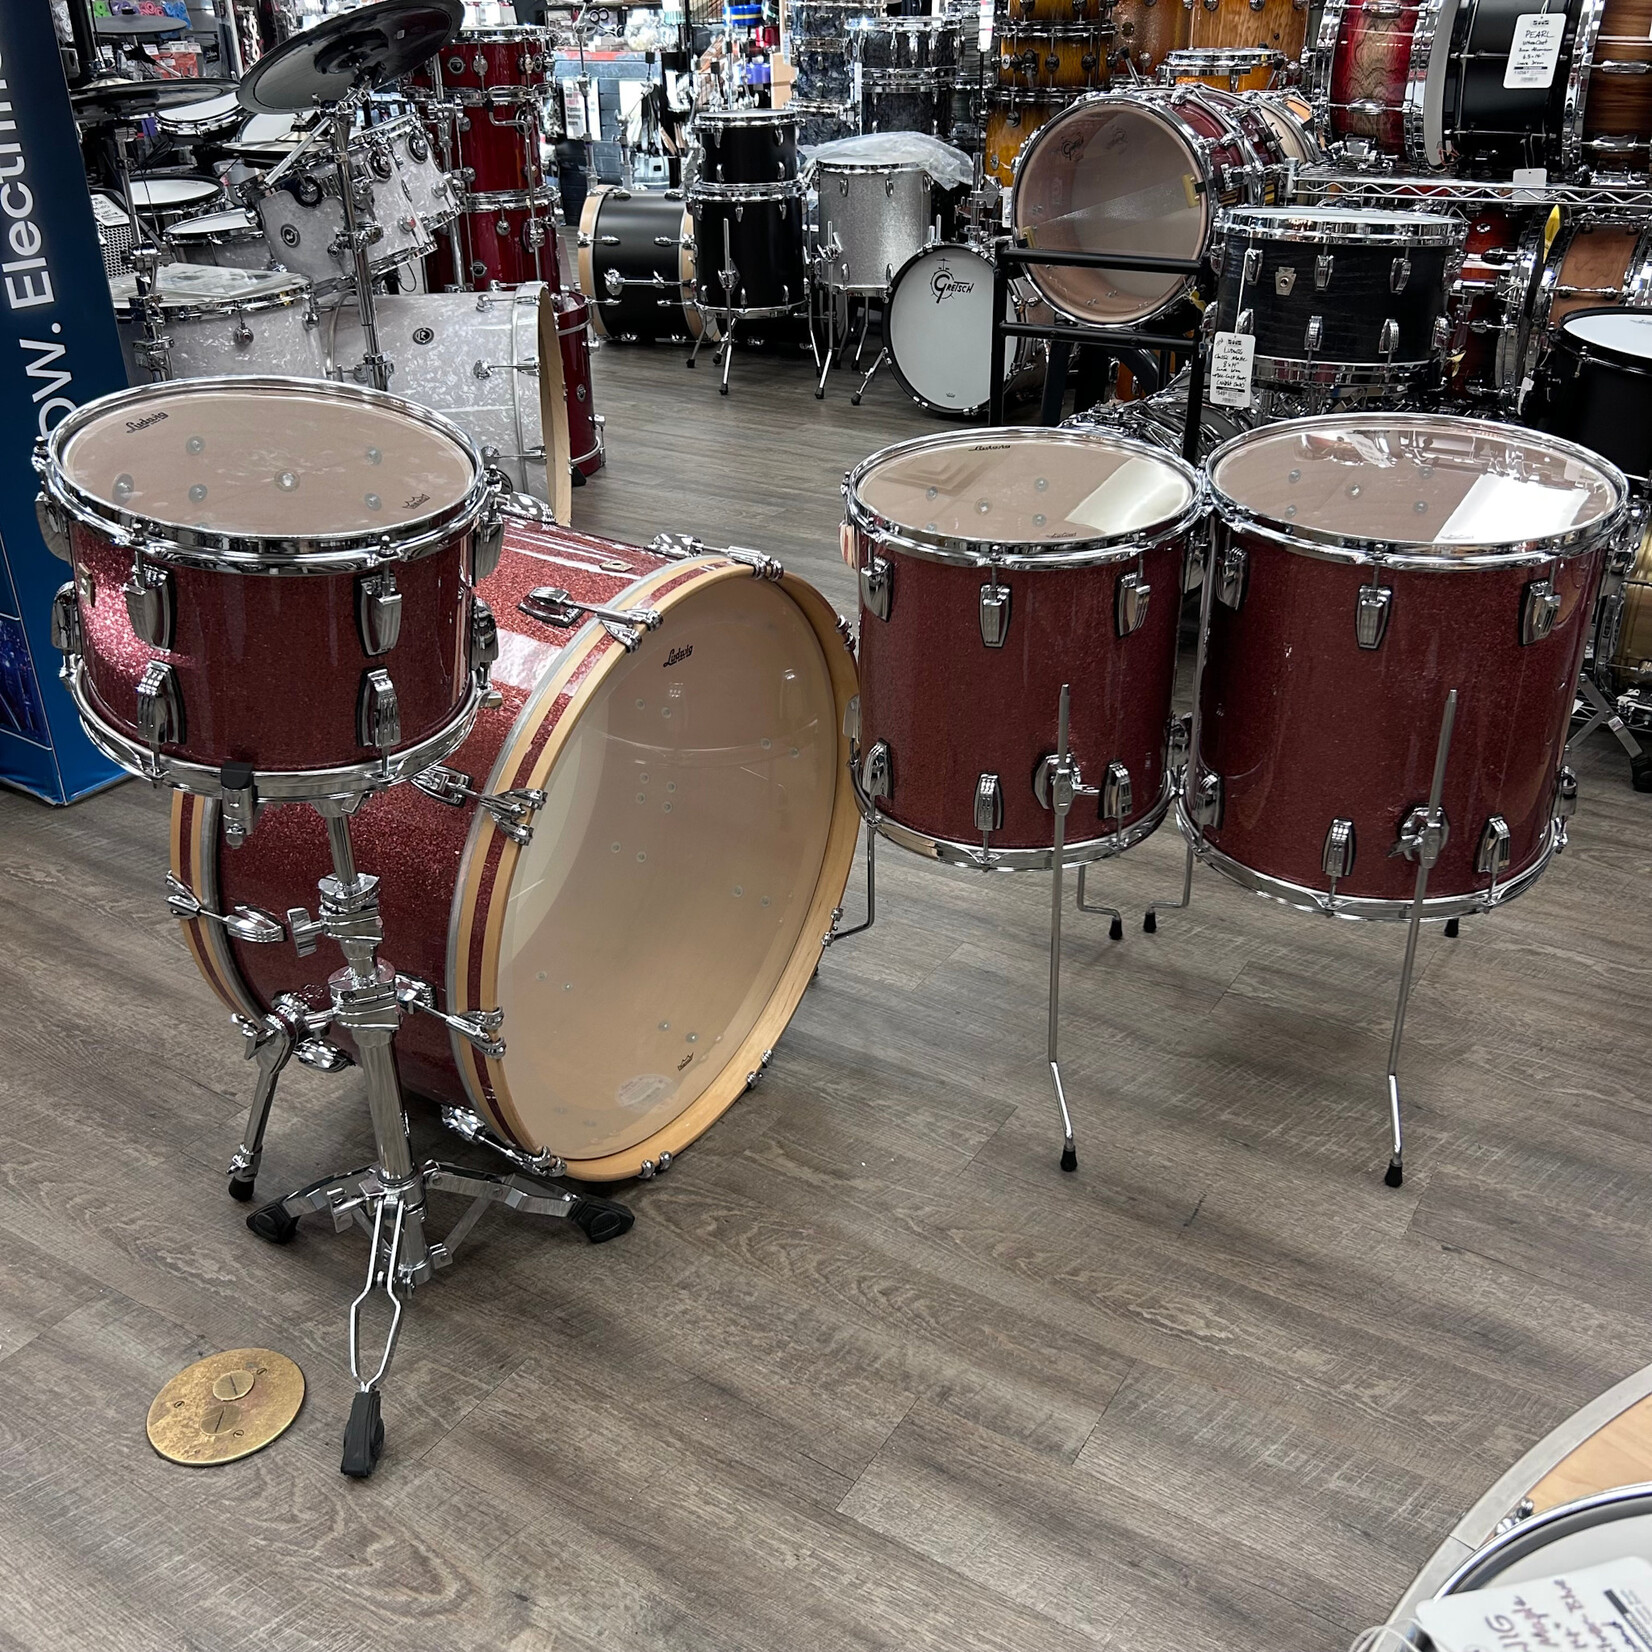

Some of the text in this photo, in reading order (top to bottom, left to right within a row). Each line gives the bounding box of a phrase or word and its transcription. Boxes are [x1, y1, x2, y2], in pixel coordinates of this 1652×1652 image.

[1525, 30, 1555, 39] PEARL
[126, 411, 169, 434] Ludwig
[662, 644, 694, 668] Ludwig
